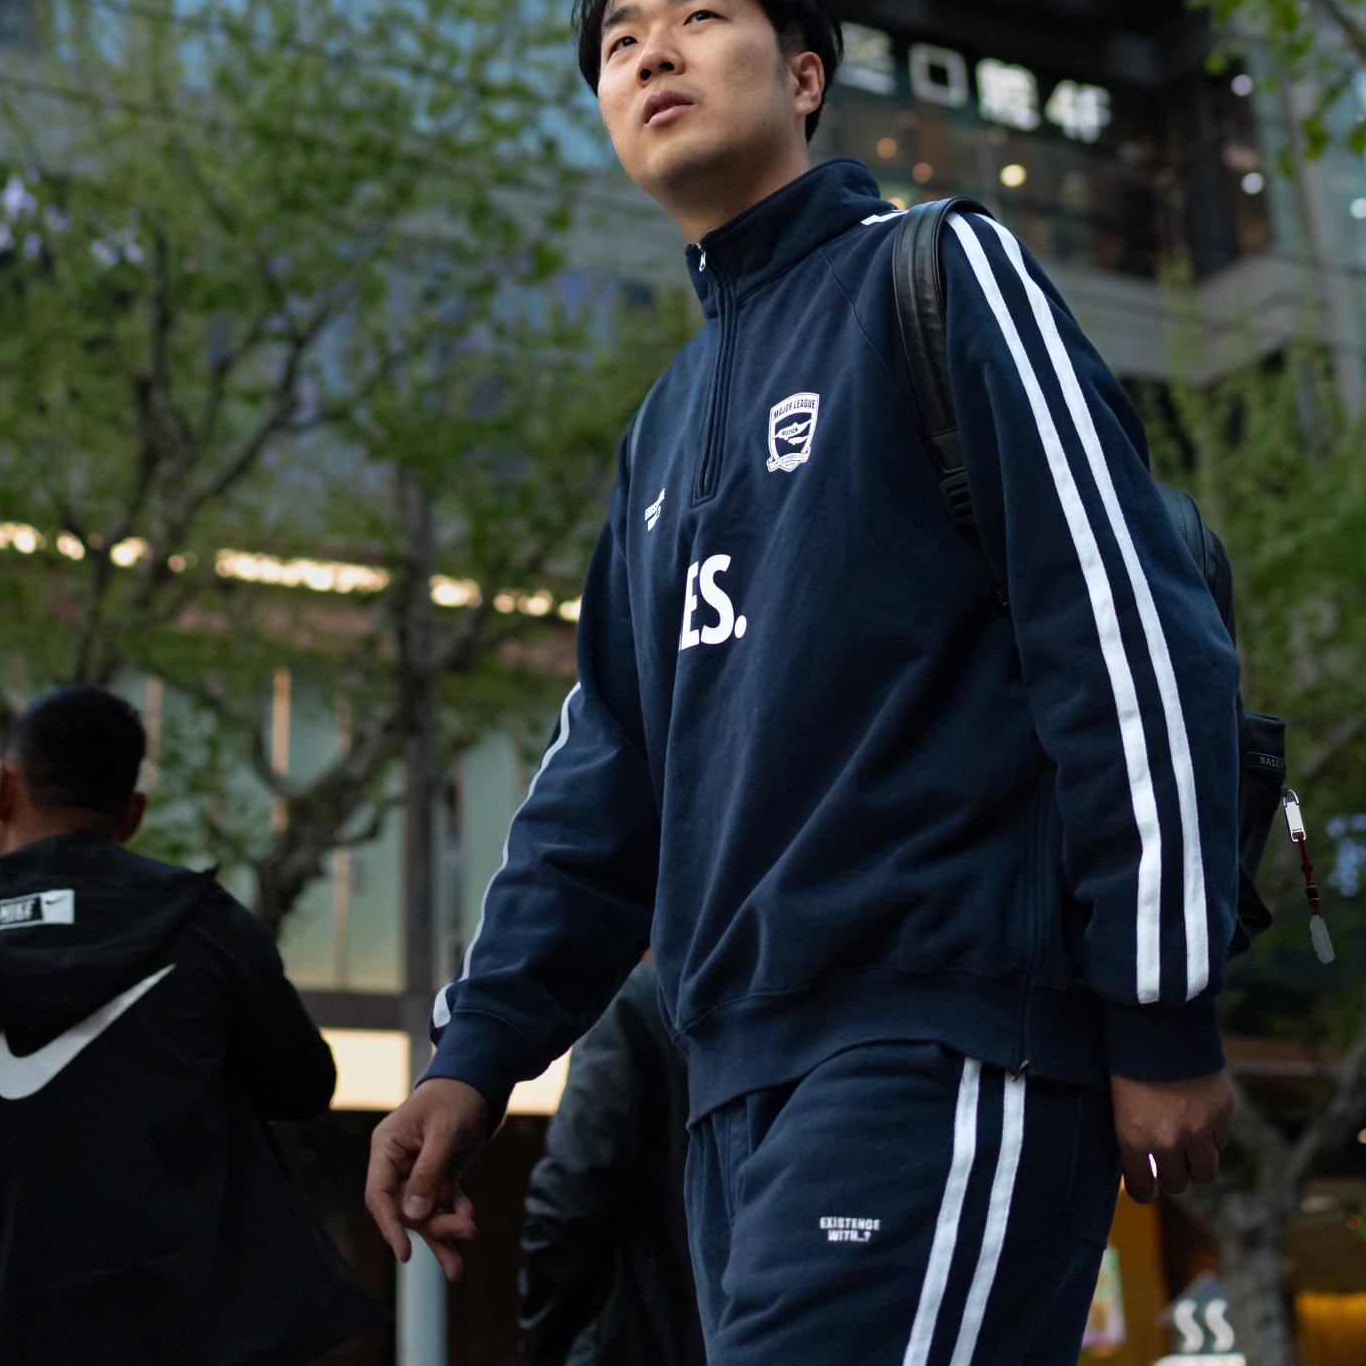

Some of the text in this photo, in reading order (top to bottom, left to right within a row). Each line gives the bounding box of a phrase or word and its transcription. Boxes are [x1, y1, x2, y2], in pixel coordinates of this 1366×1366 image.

[773, 398, 816, 420] MAJOR LEAGUE
[678, 553, 747, 652] ES.
